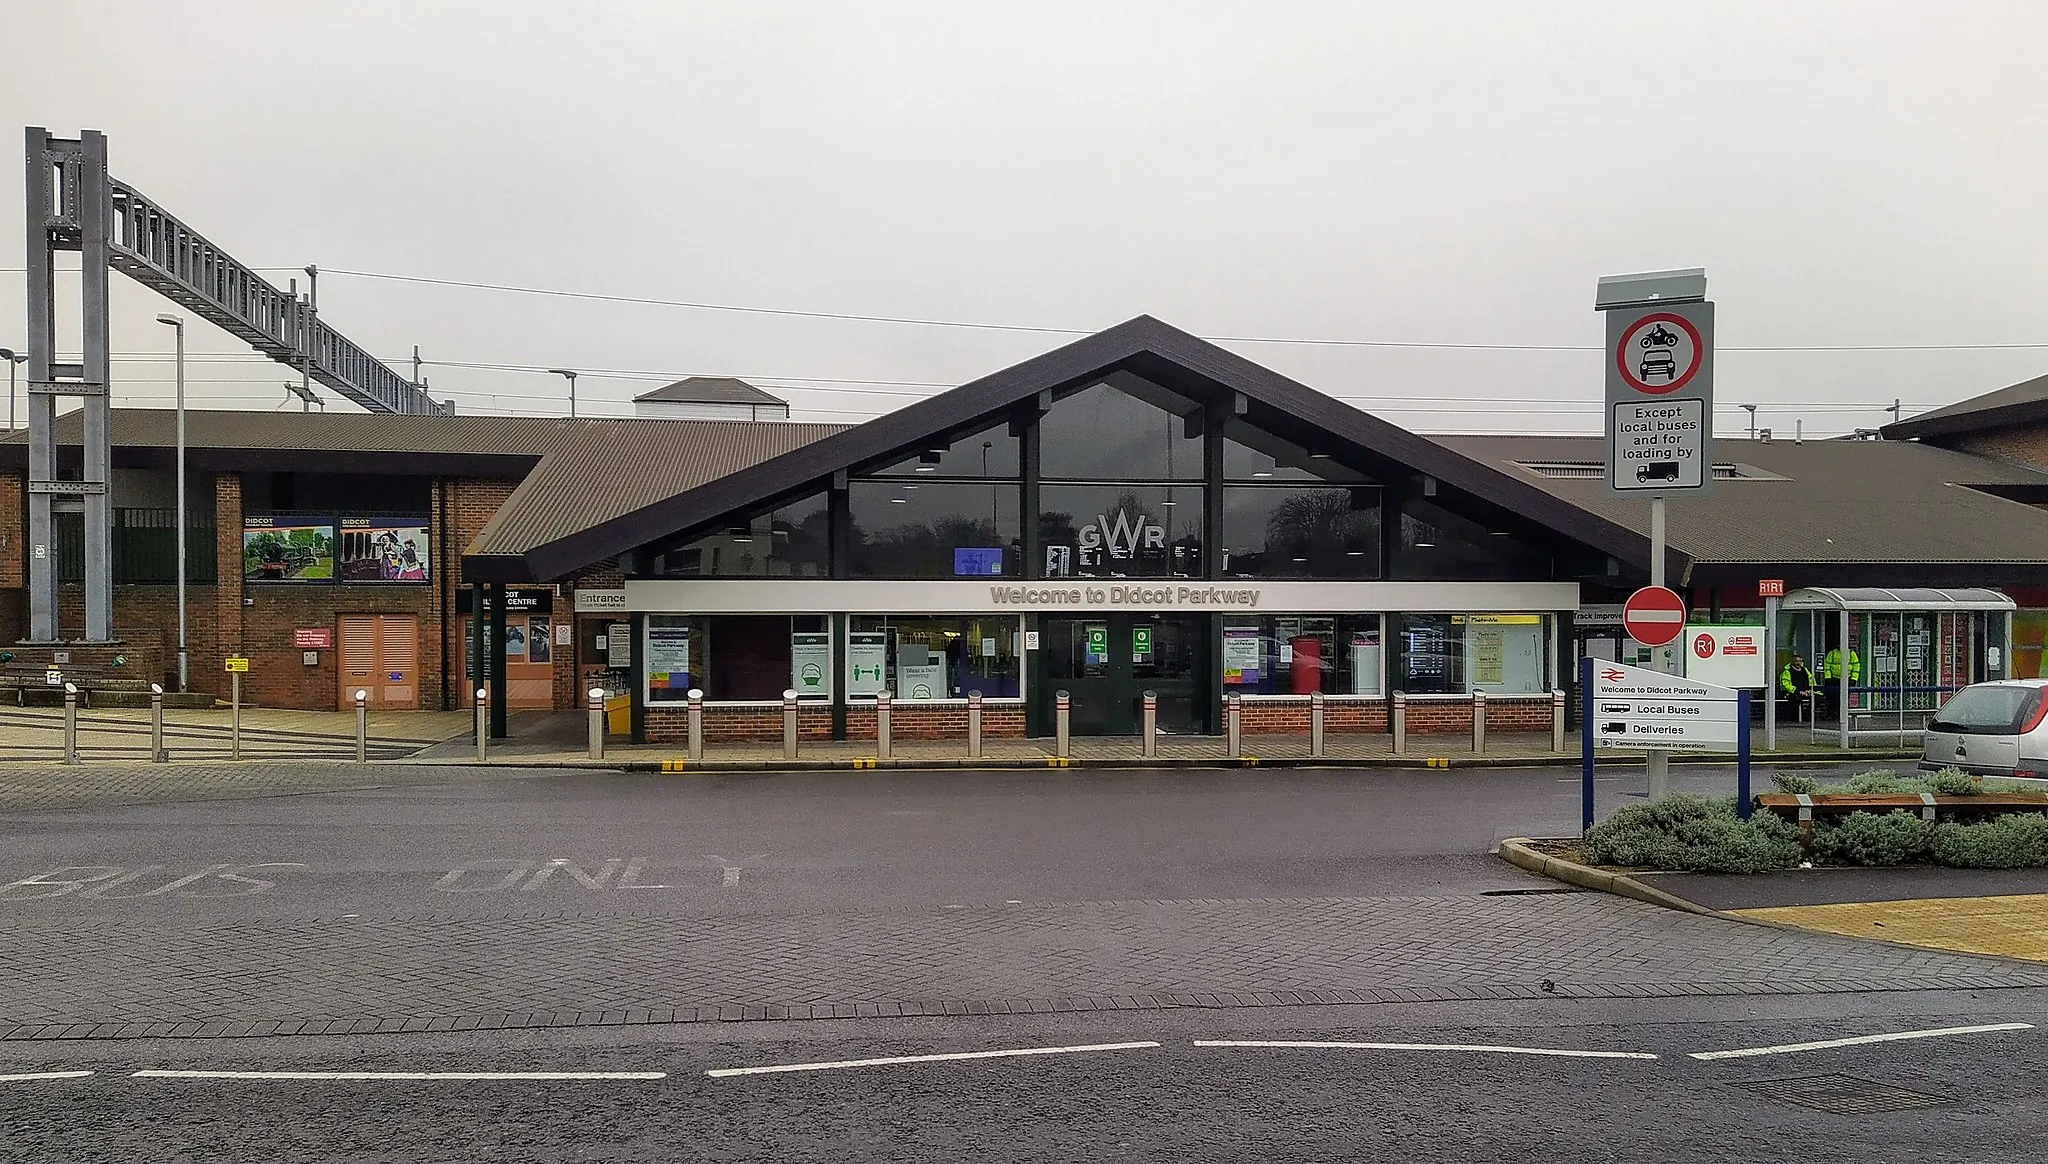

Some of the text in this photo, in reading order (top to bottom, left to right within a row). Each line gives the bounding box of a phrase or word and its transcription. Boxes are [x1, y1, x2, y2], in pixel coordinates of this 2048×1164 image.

[1635, 406, 1682, 419] Except
[1620, 420, 1697, 432] local buses
[1633, 433, 1682, 445] and for
[1622, 446, 1693, 459] loading by
[1079, 507, 1165, 555] GWR
[507, 598, 538, 606] CENTRE
[580, 593, 626, 603] Entrance
[990, 586, 1260, 607] Welcome to Didcot Parkway
[1573, 612, 1593, 620] Track
[1697, 640, 1714, 653] R1
[1600, 686, 1708, 696] Welcome to Didcot Parkway
[1637, 705, 1700, 715] Local Buses
[1632, 724, 1684, 735] Deliveries
[1636, 741, 1672, 749] enforcement
[1678, 742, 1706, 750] operation
[0, 853, 770, 900] BUS ONLY
